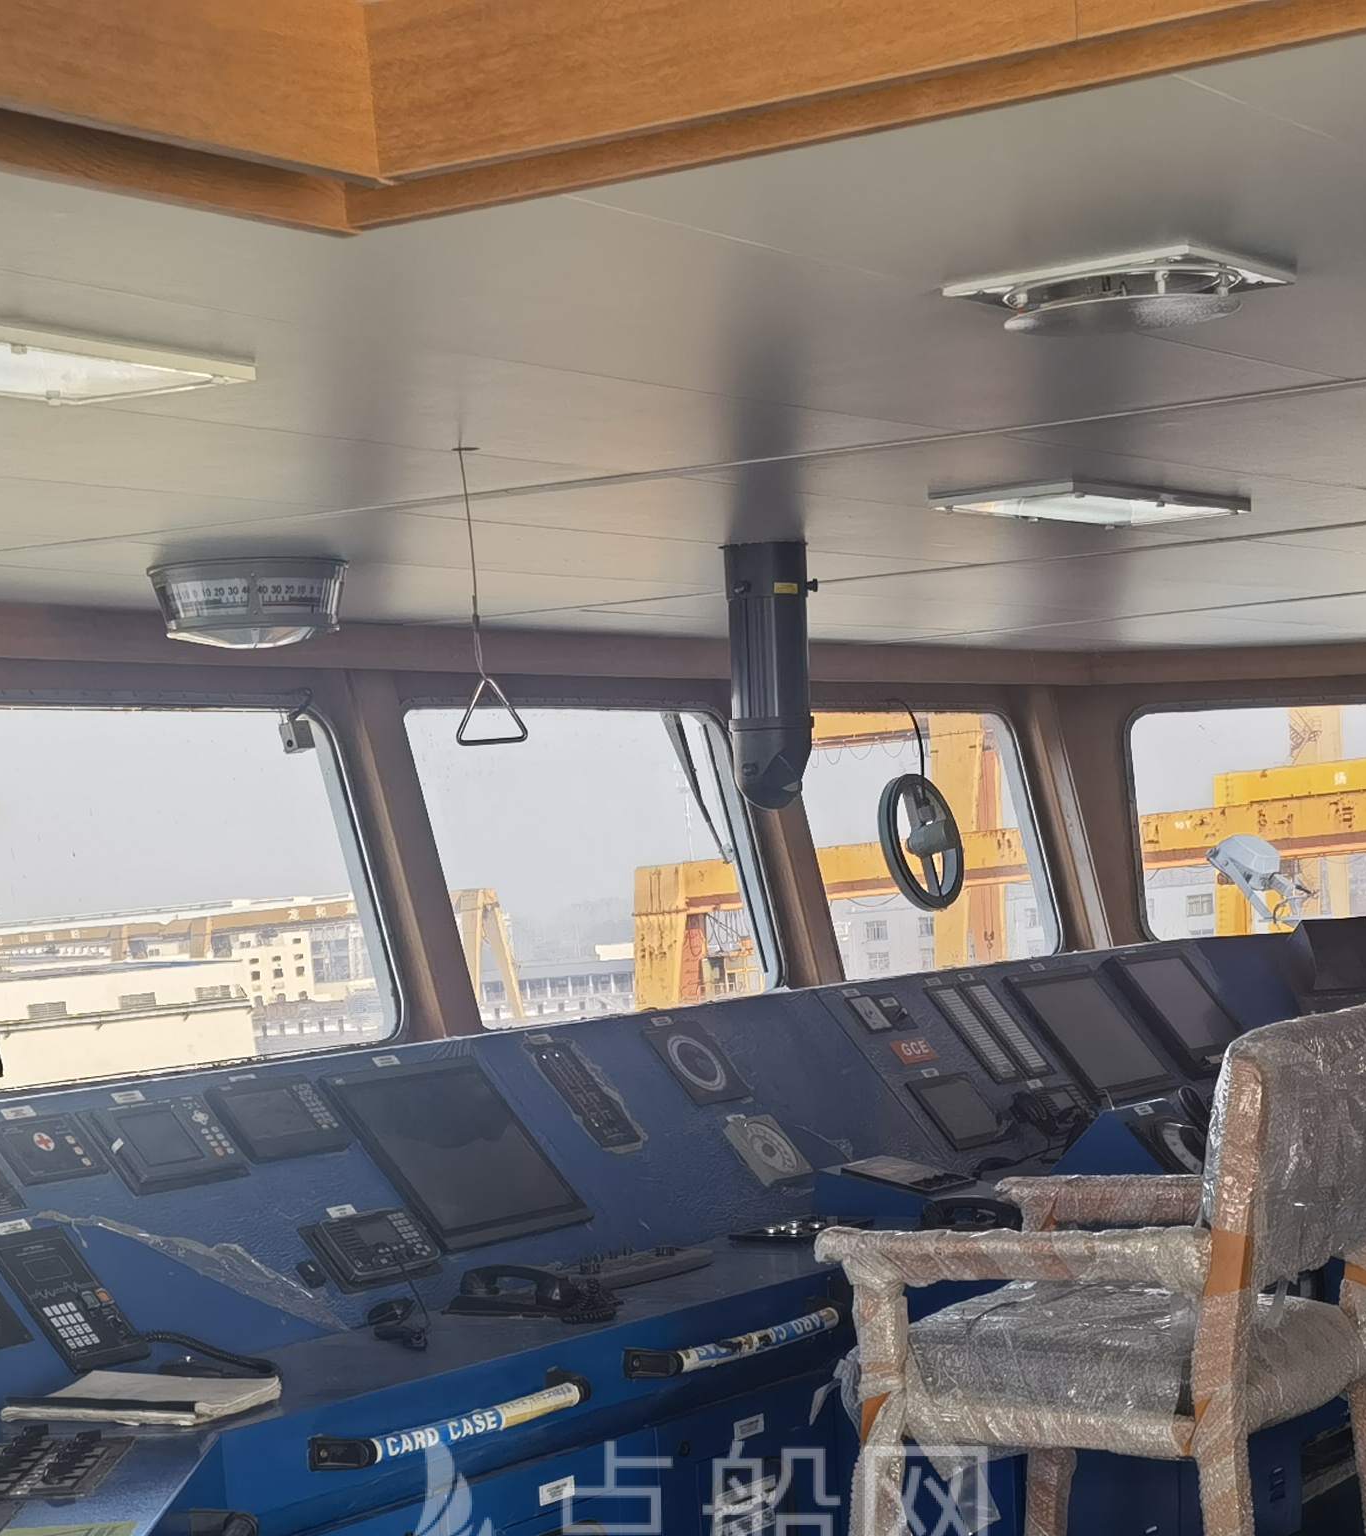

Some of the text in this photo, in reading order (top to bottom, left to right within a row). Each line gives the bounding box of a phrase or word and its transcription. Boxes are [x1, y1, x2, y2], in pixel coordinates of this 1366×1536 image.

[228, 584, 241, 596] 30
[271, 584, 283, 595] 30
[386, 1411, 497, 1457] CARD CASE
